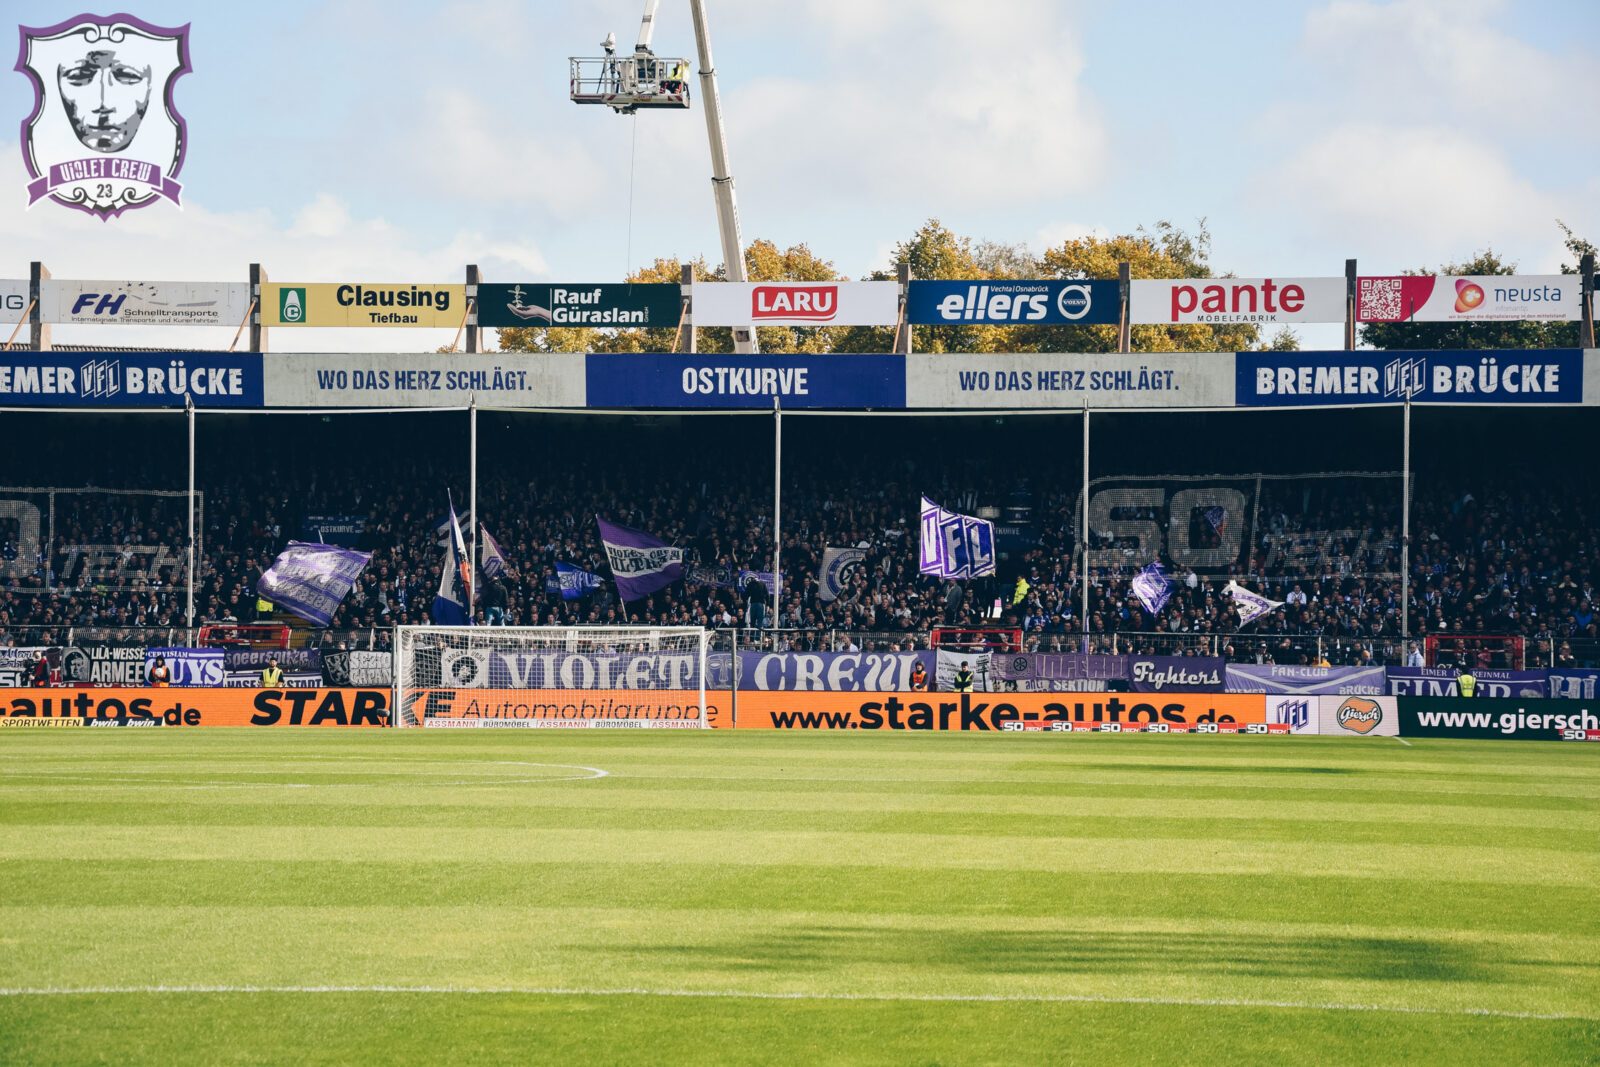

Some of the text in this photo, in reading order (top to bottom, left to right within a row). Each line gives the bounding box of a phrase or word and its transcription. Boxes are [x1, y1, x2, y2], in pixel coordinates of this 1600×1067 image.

[0, 294, 24, 309] G
[71, 294, 127, 315] FH
[336, 285, 450, 310] Clausing
[553, 288, 602, 304] Rauf
[758, 290, 832, 312] LARU
[936, 286, 1048, 320] ellers
[1171, 279, 1305, 322] pante
[1494, 285, 1562, 302] neusta
[124, 308, 218, 318] Schnelltransporte
[369, 312, 418, 324] Tiefbau
[552, 306, 644, 323] Güraslan
[126, 360, 243, 394] BRÜCKE
[317, 366, 533, 392] WO DAS HERZ SCHLÄGT.
[682, 367, 809, 395] OSTKURVE
[959, 366, 1180, 391] WO DAS HERZ SCHLÄGT.
[1256, 366, 1380, 395] BREMER
[1432, 357, 1560, 393] BRÜCKE
[90, 661, 145, 683] ARMEE
[501, 653, 695, 690] VIOLET
[1133, 661, 1221, 689] Fighters
[1271, 667, 1329, 677] FAN-CLUB
[1421, 668, 1448, 677] EIMER
[1472, 671, 1511, 680] KEINMAL
[1389, 679, 1512, 698] EIMR
[0, 693, 201, 726] autosde
[770, 694, 1236, 730] www.starke-autosde
[2, 718, 81, 726] SPORTWETTEN
[427, 720, 476, 728] ASSMANN
[483, 720, 531, 728] BÜROMÖBEL
[540, 720, 587, 728] ASSMANN
[651, 721, 700, 729] ASSMANN
[1003, 722, 1024, 731] SO
[1051, 722, 1073, 732] SO
[1100, 723, 1121, 732] SO
[1148, 724, 1169, 733] SO
[1197, 724, 1218, 733] SO
[1247, 724, 1268, 734] SO
[1417, 709, 1600, 734] www.giersch
[1563, 730, 1586, 740] SO
